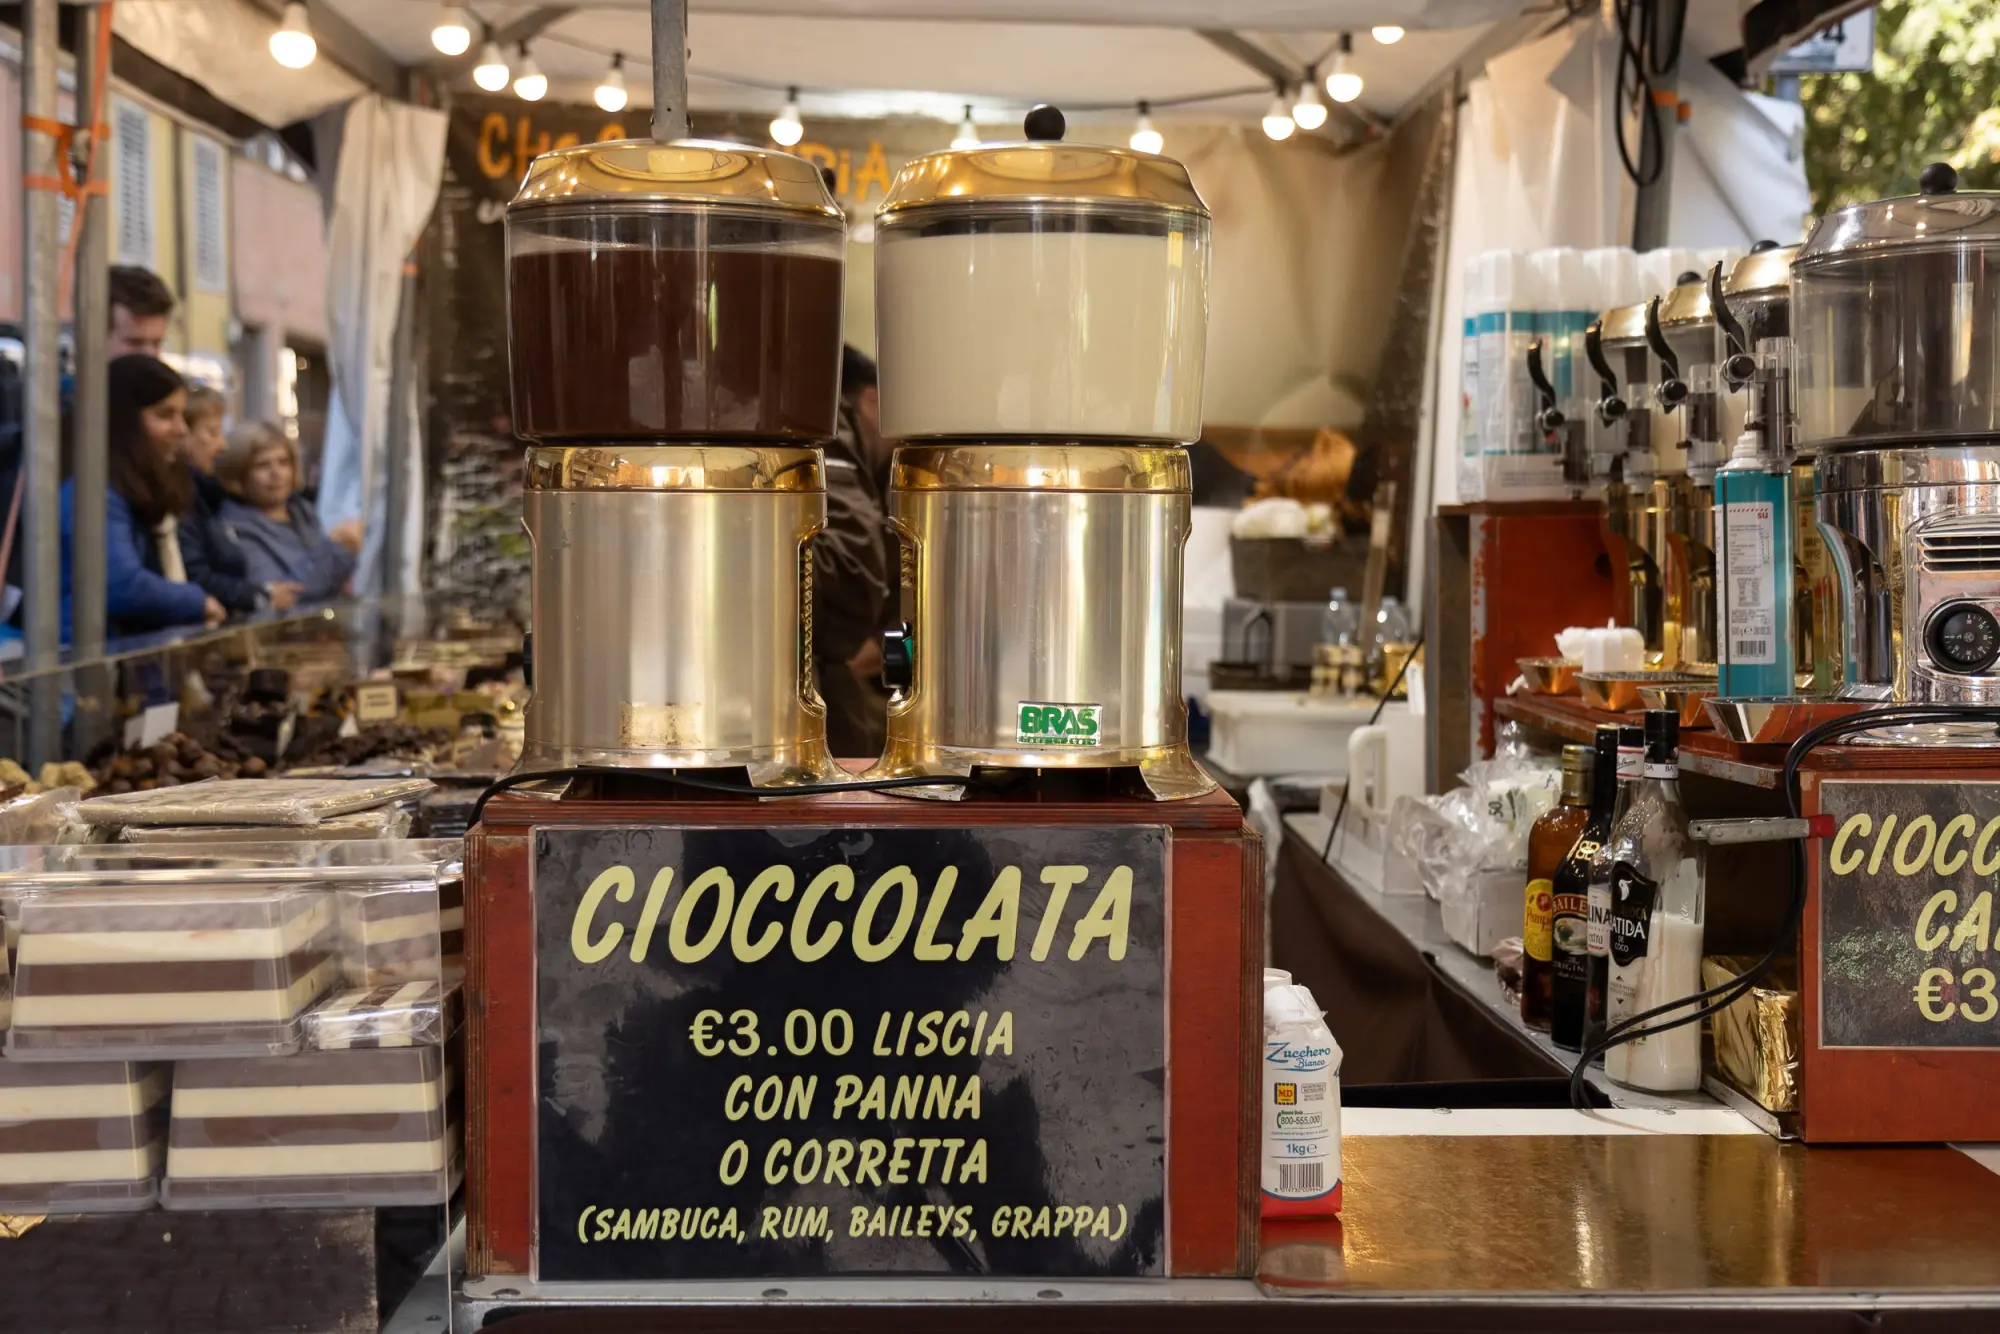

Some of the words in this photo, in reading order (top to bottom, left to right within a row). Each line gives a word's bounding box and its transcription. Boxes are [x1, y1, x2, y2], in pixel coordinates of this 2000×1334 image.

[1021, 706, 1098, 736] BRAS
[570, 864, 1134, 964] CIOCCOLATA
[1914, 889, 2000, 953] CA
[689, 1008, 854, 1057] €3.00
[873, 1010, 1013, 1057] LISCIA
[1266, 1042, 1331, 1063] Zucchero
[1294, 1057, 1325, 1069] Bianco
[725, 1075, 818, 1121] CON
[833, 1074, 981, 1120] PANNA
[1278, 1089, 1293, 1098] MD
[719, 1139, 749, 1185] O
[764, 1137, 987, 1187] CORRETTA
[577, 1205, 746, 1243] (SAMBUCA,
[760, 1206, 834, 1243] RUM,
[848, 1205, 977, 1242] BAILEYS,
[991, 1203, 1128, 1242] GRAPPA)
